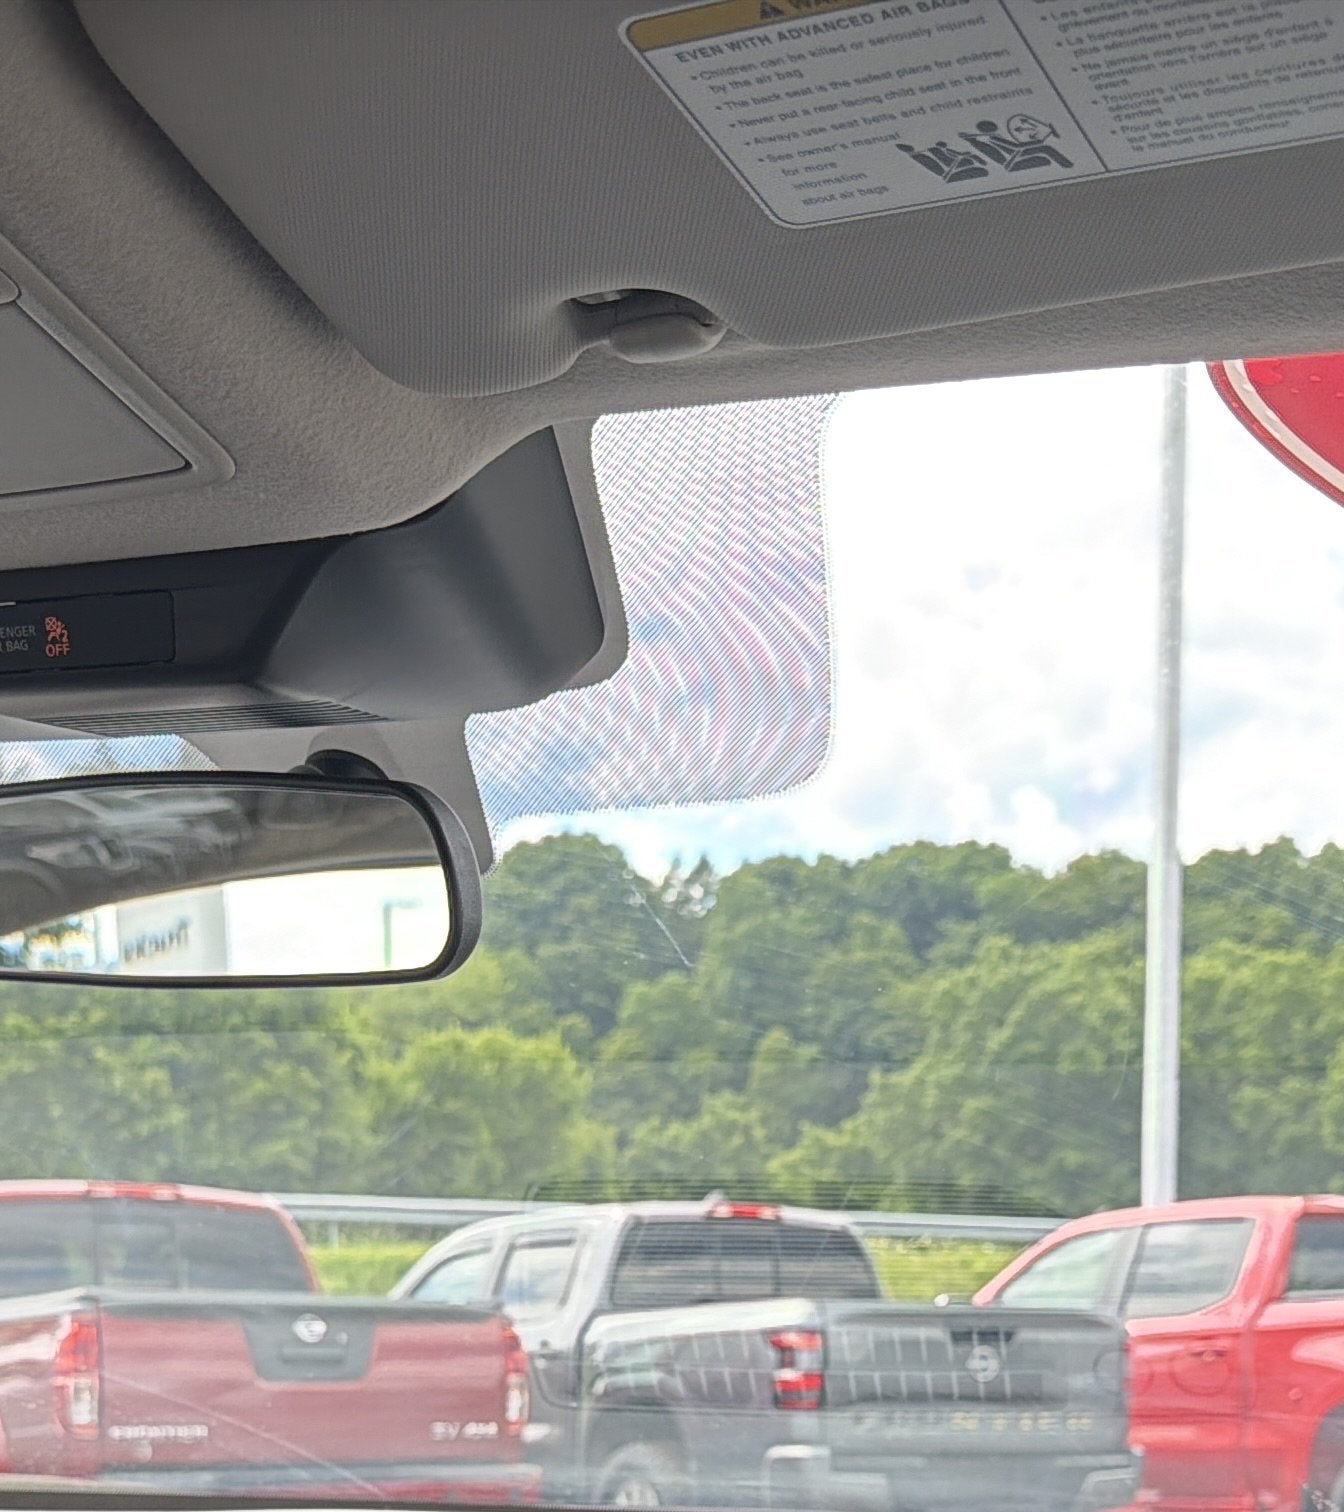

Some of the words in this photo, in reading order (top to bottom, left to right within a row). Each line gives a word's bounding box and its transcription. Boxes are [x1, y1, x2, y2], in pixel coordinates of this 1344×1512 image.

[675, 45, 724, 63] EVEN
[724, 34, 773, 51] WITH
[776, 12, 874, 42] ADVANCED
[880, 4, 913, 20] AIR
[699, 62, 757, 80] Children
[760, 57, 785, 69] can
[808, 43, 847, 58] killed
[850, 40, 864, 51] or
[868, 27, 932, 47] seriously
[723, 100, 749, 110] The
[754, 131, 800, 145] Always
[6, 640, 29, 652] BAG
[46, 643, 70, 657] OFF
